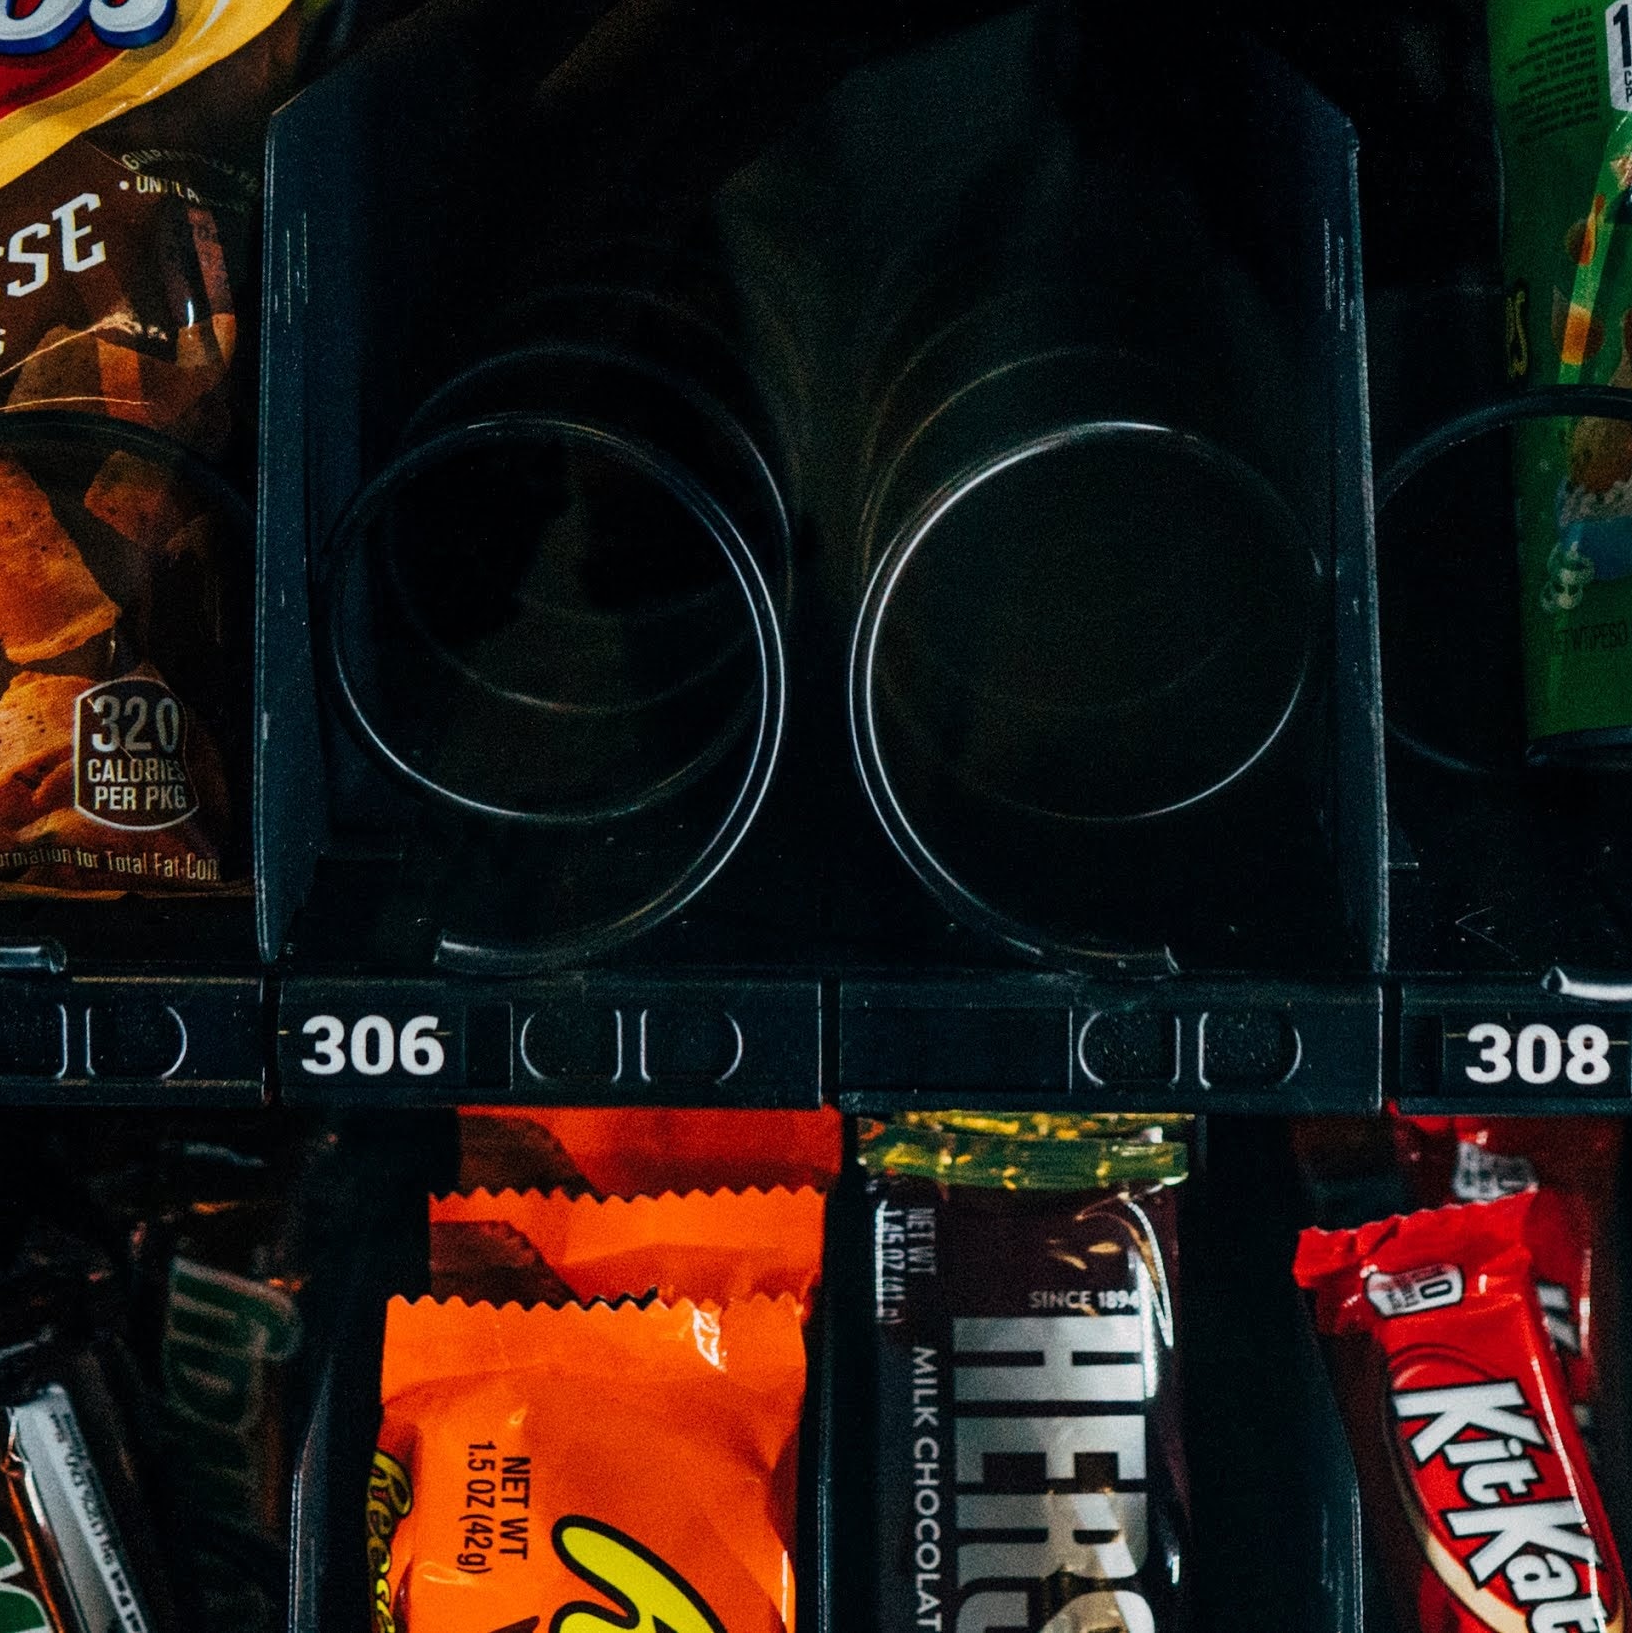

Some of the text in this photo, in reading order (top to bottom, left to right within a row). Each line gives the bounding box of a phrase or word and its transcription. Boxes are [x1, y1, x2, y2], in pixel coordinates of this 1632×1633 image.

[91, 695, 181, 754] 320
[87, 757, 187, 784] CALORIES
[94, 785, 188, 812] PER PKG
[76, 847, 99, 869] for
[105, 850, 149, 874] Total
[301, 1014, 445, 1076] 306
[1463, 1023, 1613, 1086] 308
[908, 1207, 938, 1276] NET WT
[1029, 1290, 1140, 1310] SINCE 1894
[912, 1345, 940, 1428] MILK
[455, 1441, 498, 1577] 1.5 OZ (42g)
[499, 1456, 532, 1562] NET WT
